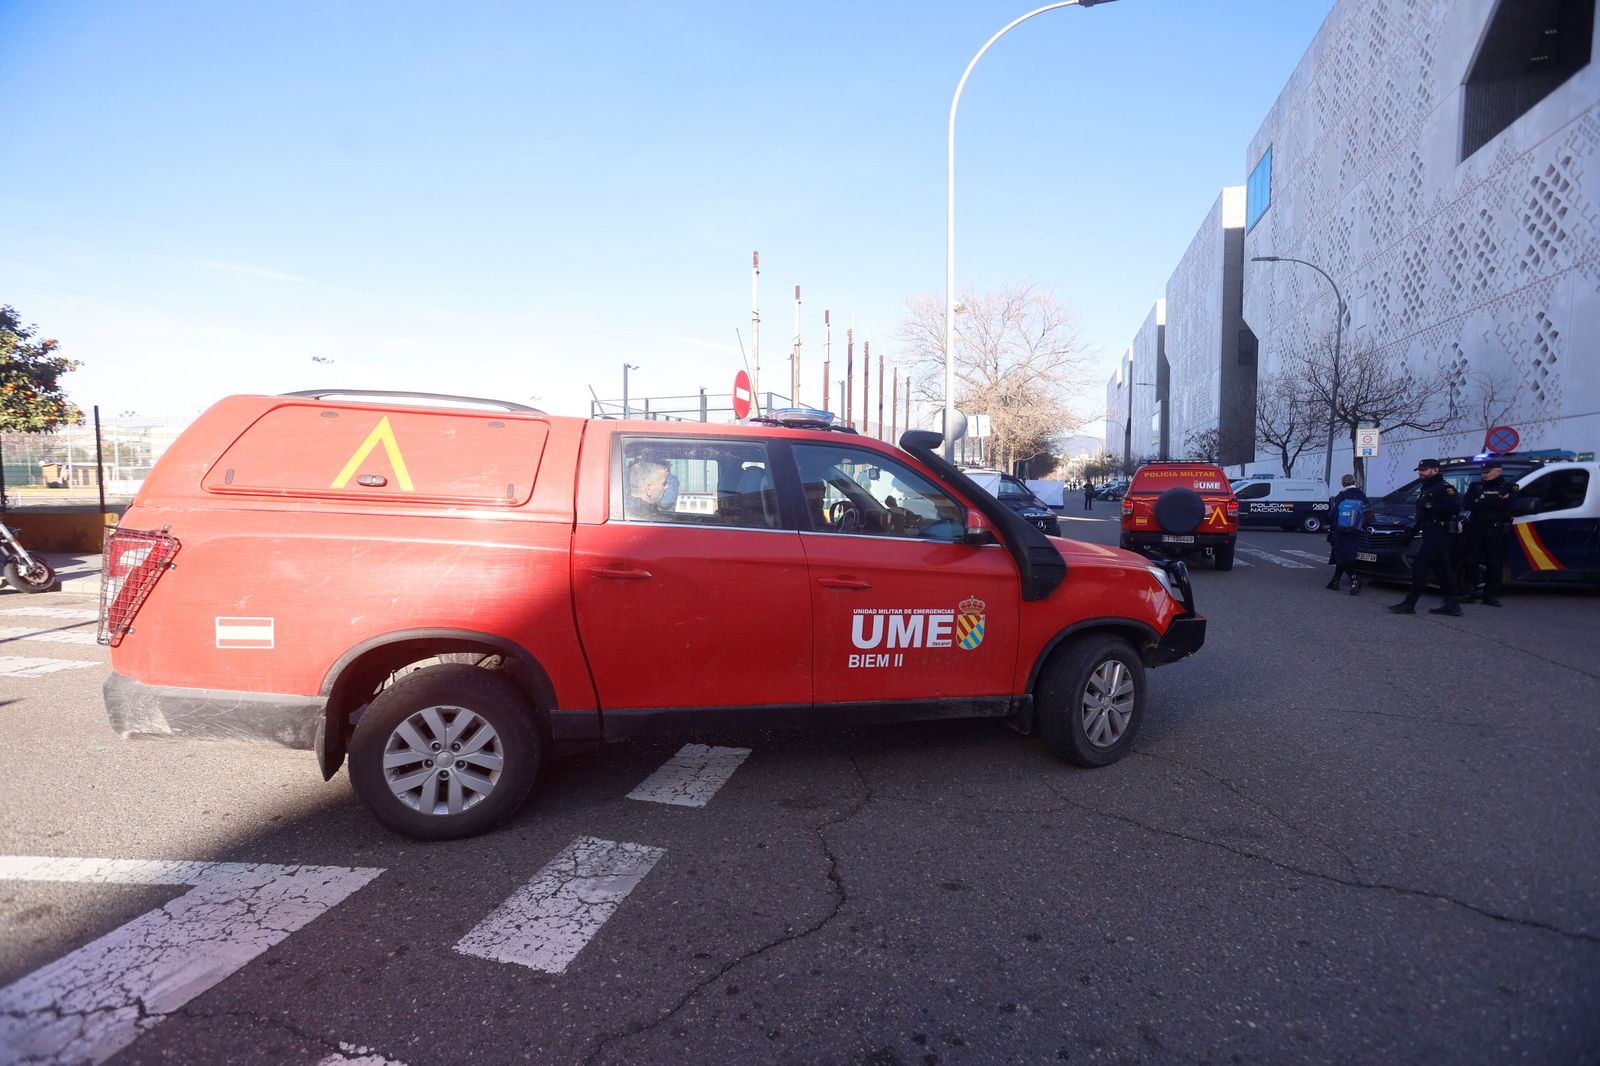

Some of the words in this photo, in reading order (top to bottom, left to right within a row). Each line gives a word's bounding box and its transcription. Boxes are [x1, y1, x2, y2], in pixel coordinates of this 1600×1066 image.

[851, 614, 954, 649] UME
[848, 654, 889, 668] BIEM
[894, 653, 904, 667] II
